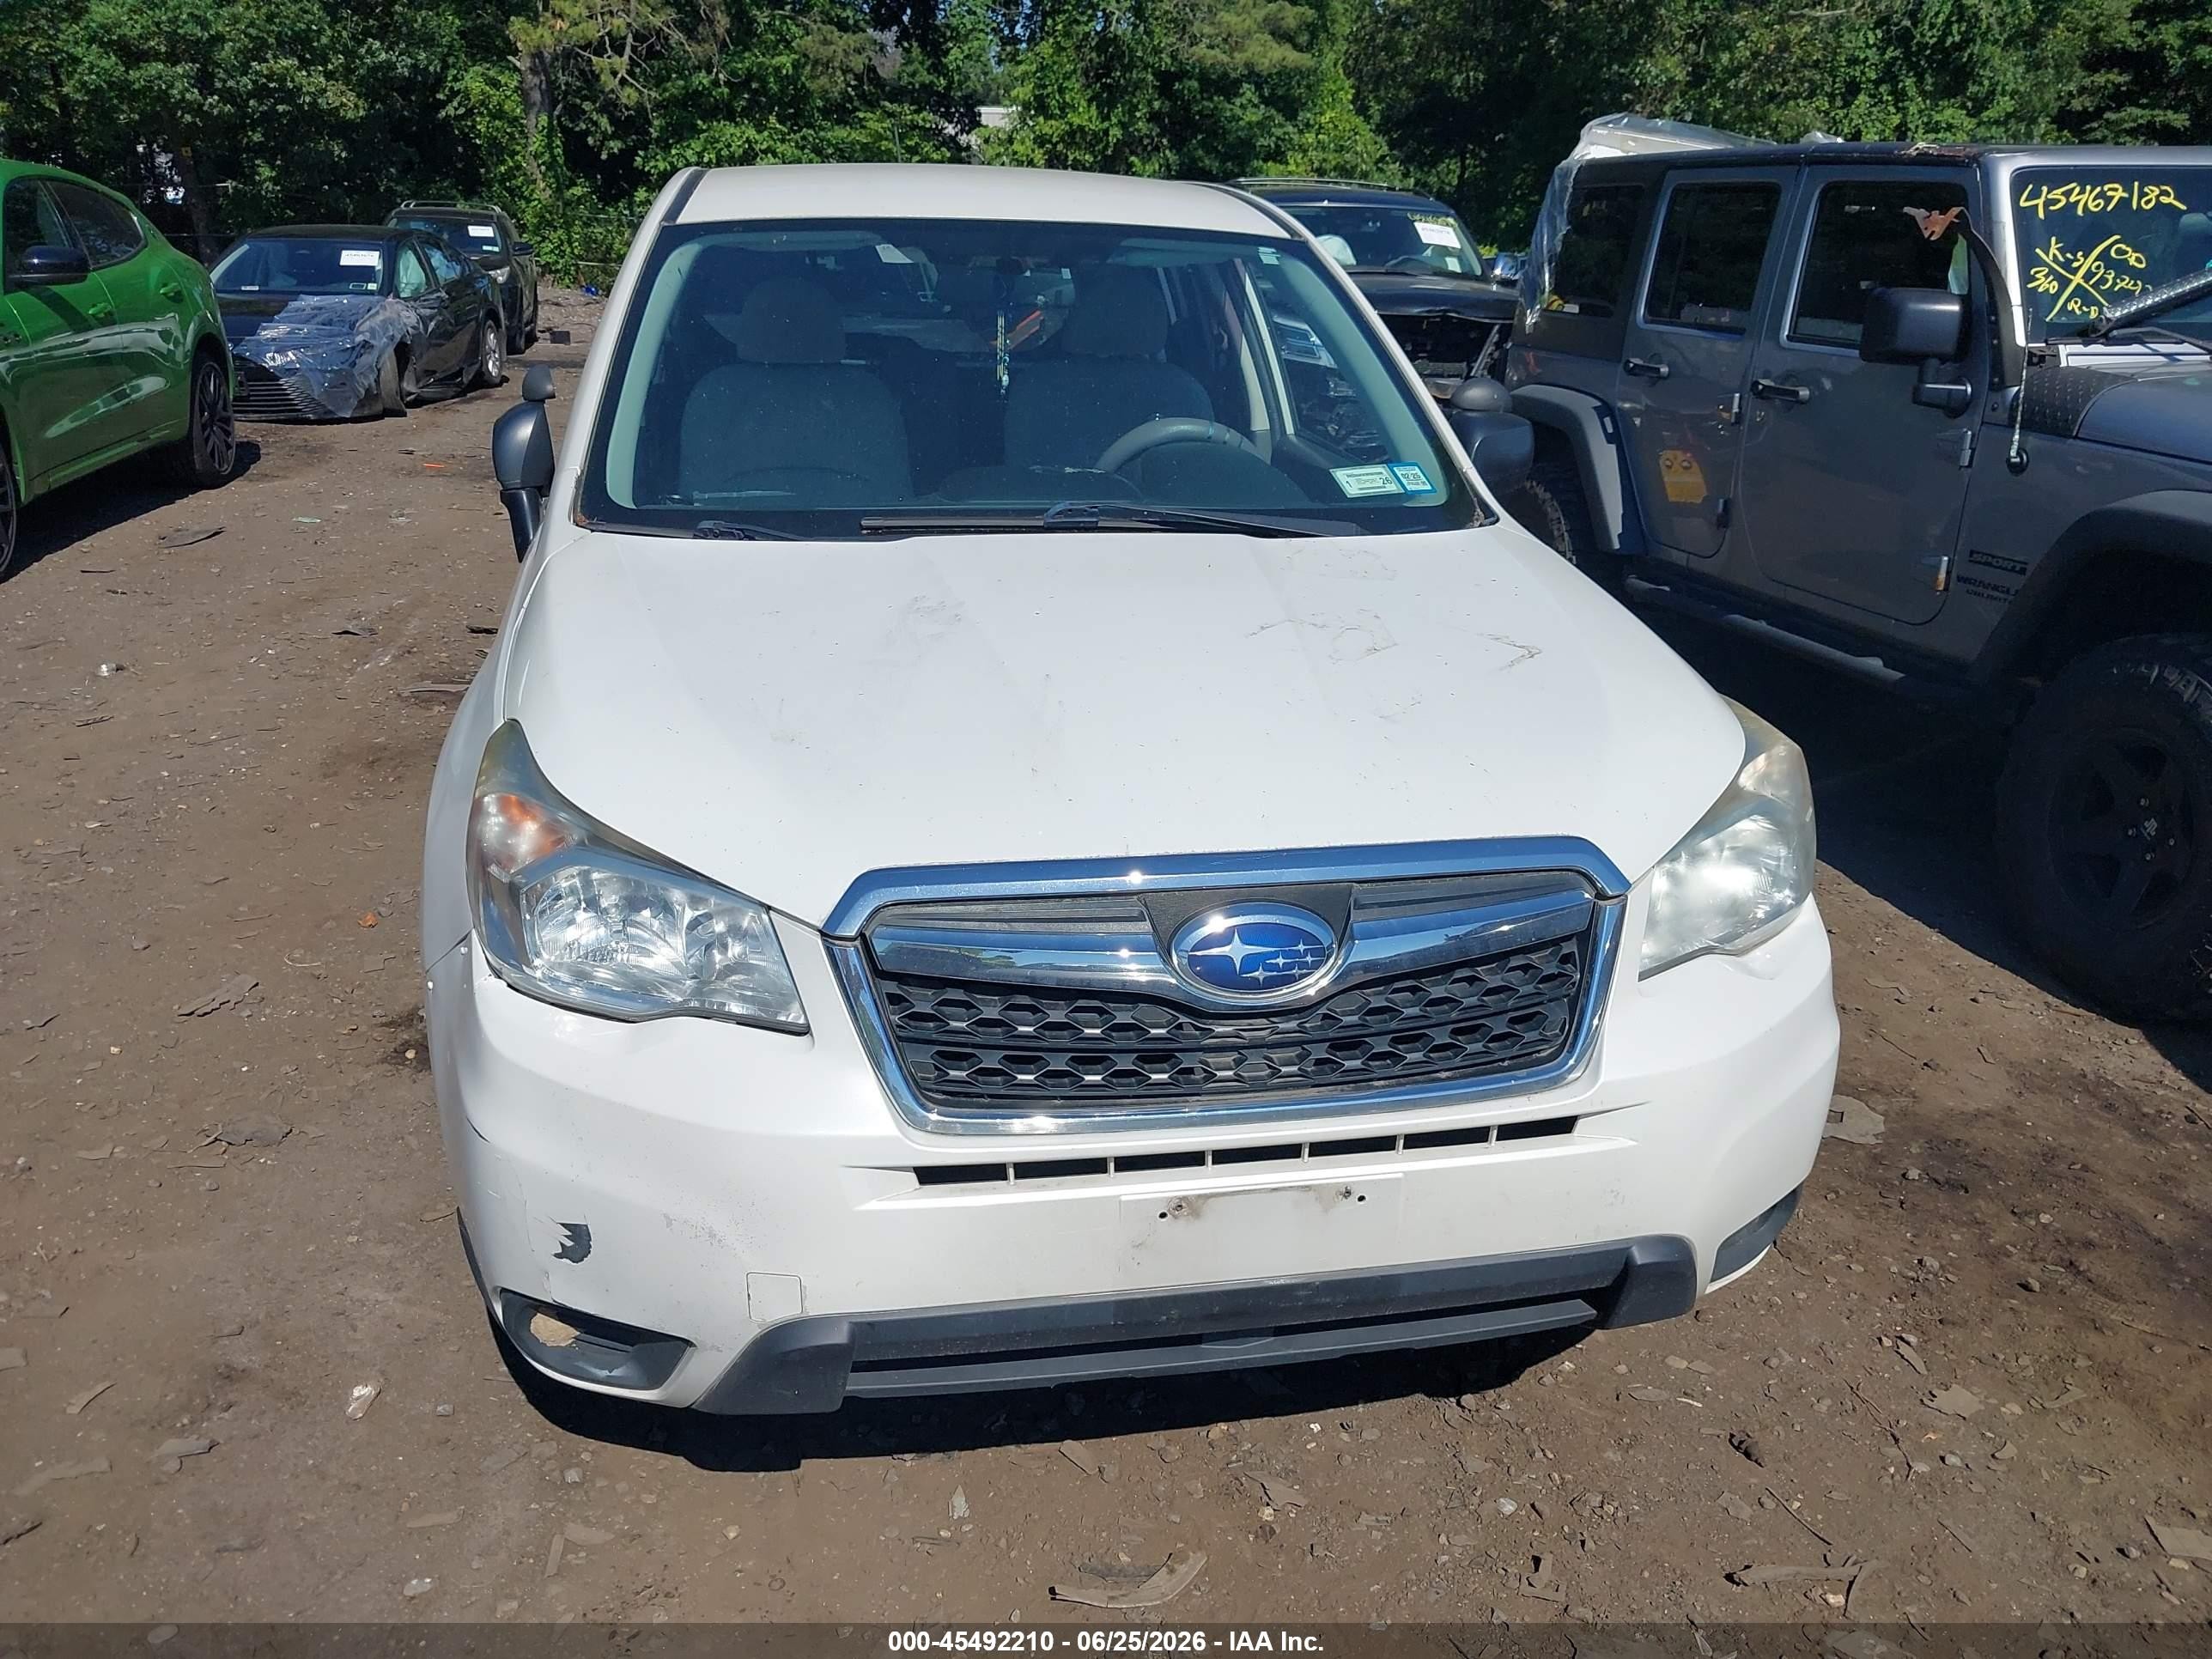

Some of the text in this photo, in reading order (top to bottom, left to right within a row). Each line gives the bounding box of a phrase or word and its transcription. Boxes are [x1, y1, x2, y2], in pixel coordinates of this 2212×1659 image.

[2019, 181, 2187, 220] 45467182
[1379, 477, 1393, 485] 26
[1971, 552, 2028, 574] SPORT
